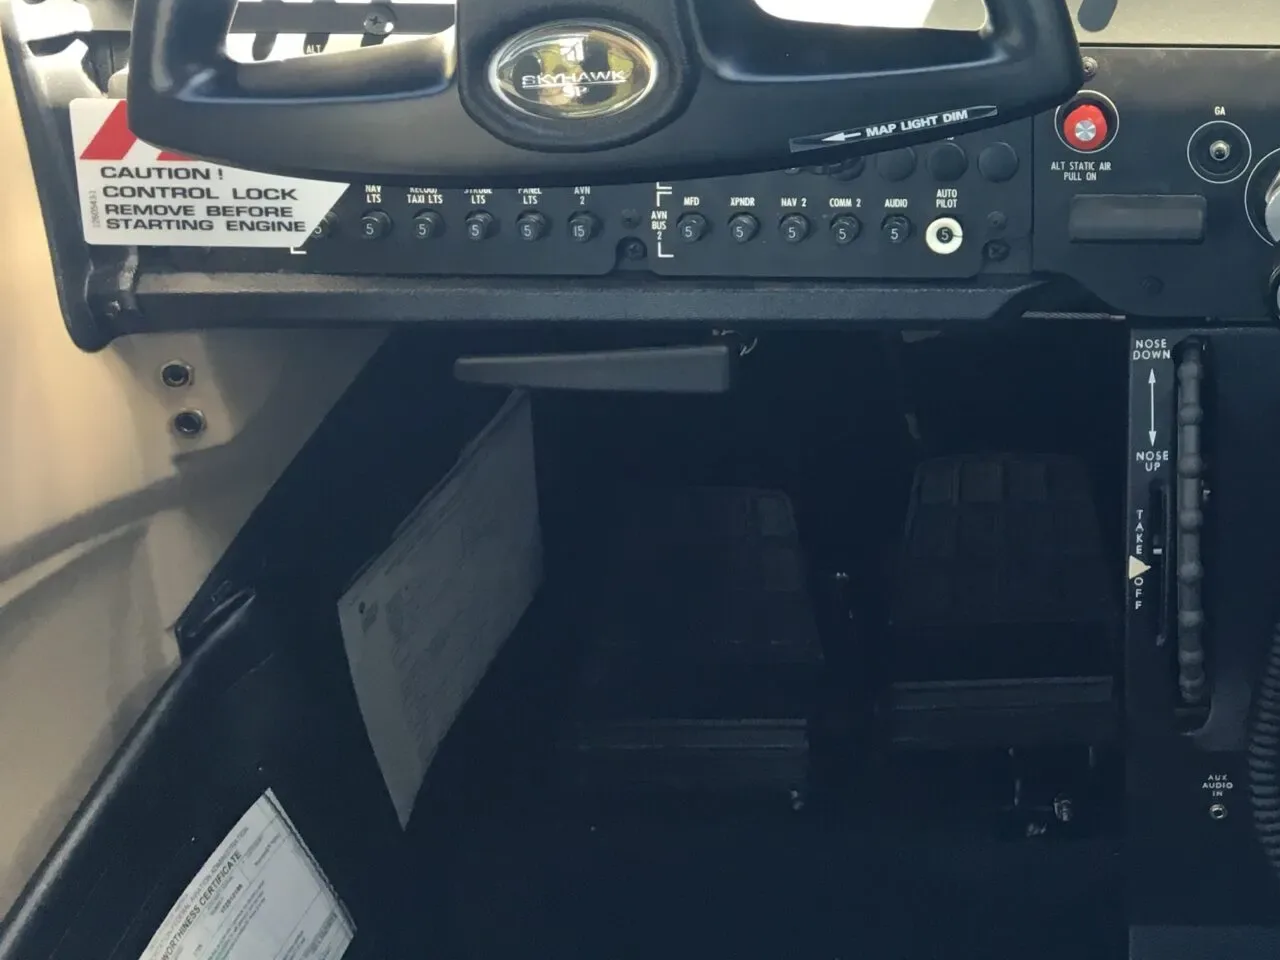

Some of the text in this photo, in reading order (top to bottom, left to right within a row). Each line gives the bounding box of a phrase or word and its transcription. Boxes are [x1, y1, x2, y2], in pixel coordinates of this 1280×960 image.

[522, 70, 626, 88] SKYHAWK
[1214, 107, 1225, 116] GA
[866, 110, 968, 138] MAP LIGHT DIM
[1050, 162, 1112, 171] ALT STATIC AIR
[100, 166, 223, 180] CAUTION !
[1063, 172, 1096, 181] PULL ON
[102, 185, 298, 200] CONTROL LOCK
[936, 189, 957, 198] AUTO
[683, 197, 699, 206] MFD
[730, 197, 755, 206] XPNDR
[885, 199, 908, 208] AUDIO
[936, 199, 958, 208] PILOT
[105, 204, 293, 218] REMOVE BEFORE
[651, 211, 667, 219] AVN
[107, 218, 306, 232] STARTING ENGINE
[652, 221, 667, 230] BUS
[657, 231, 662, 240] 2
[1135, 339, 1167, 349] NOSE
[1133, 350, 1170, 360] DOWN
[1136, 451, 1169, 461] NOSE
[1145, 462, 1161, 472] UP
